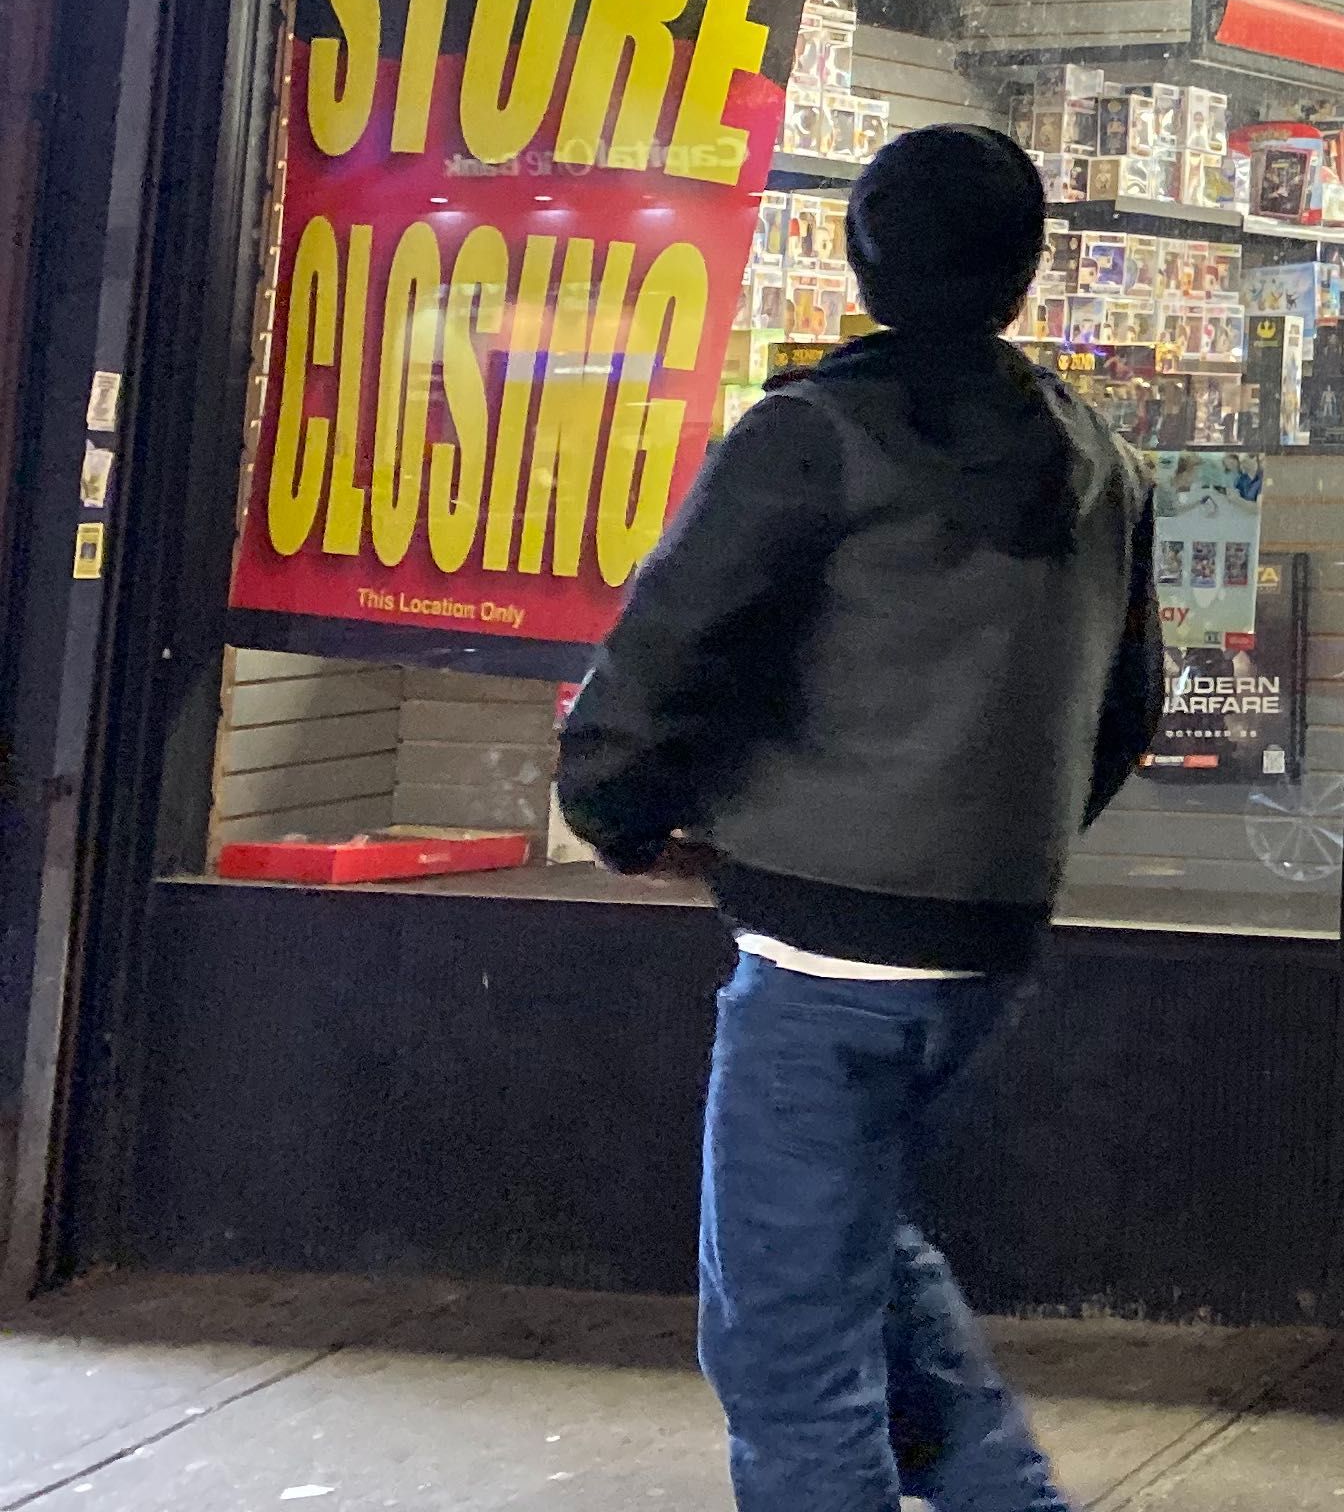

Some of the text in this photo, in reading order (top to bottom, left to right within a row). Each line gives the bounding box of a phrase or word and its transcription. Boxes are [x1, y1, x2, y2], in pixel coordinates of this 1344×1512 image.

[267, 215, 709, 588] CLOSING
[358, 587, 526, 630] This Location Only
[1164, 675, 1280, 694] ODERN
